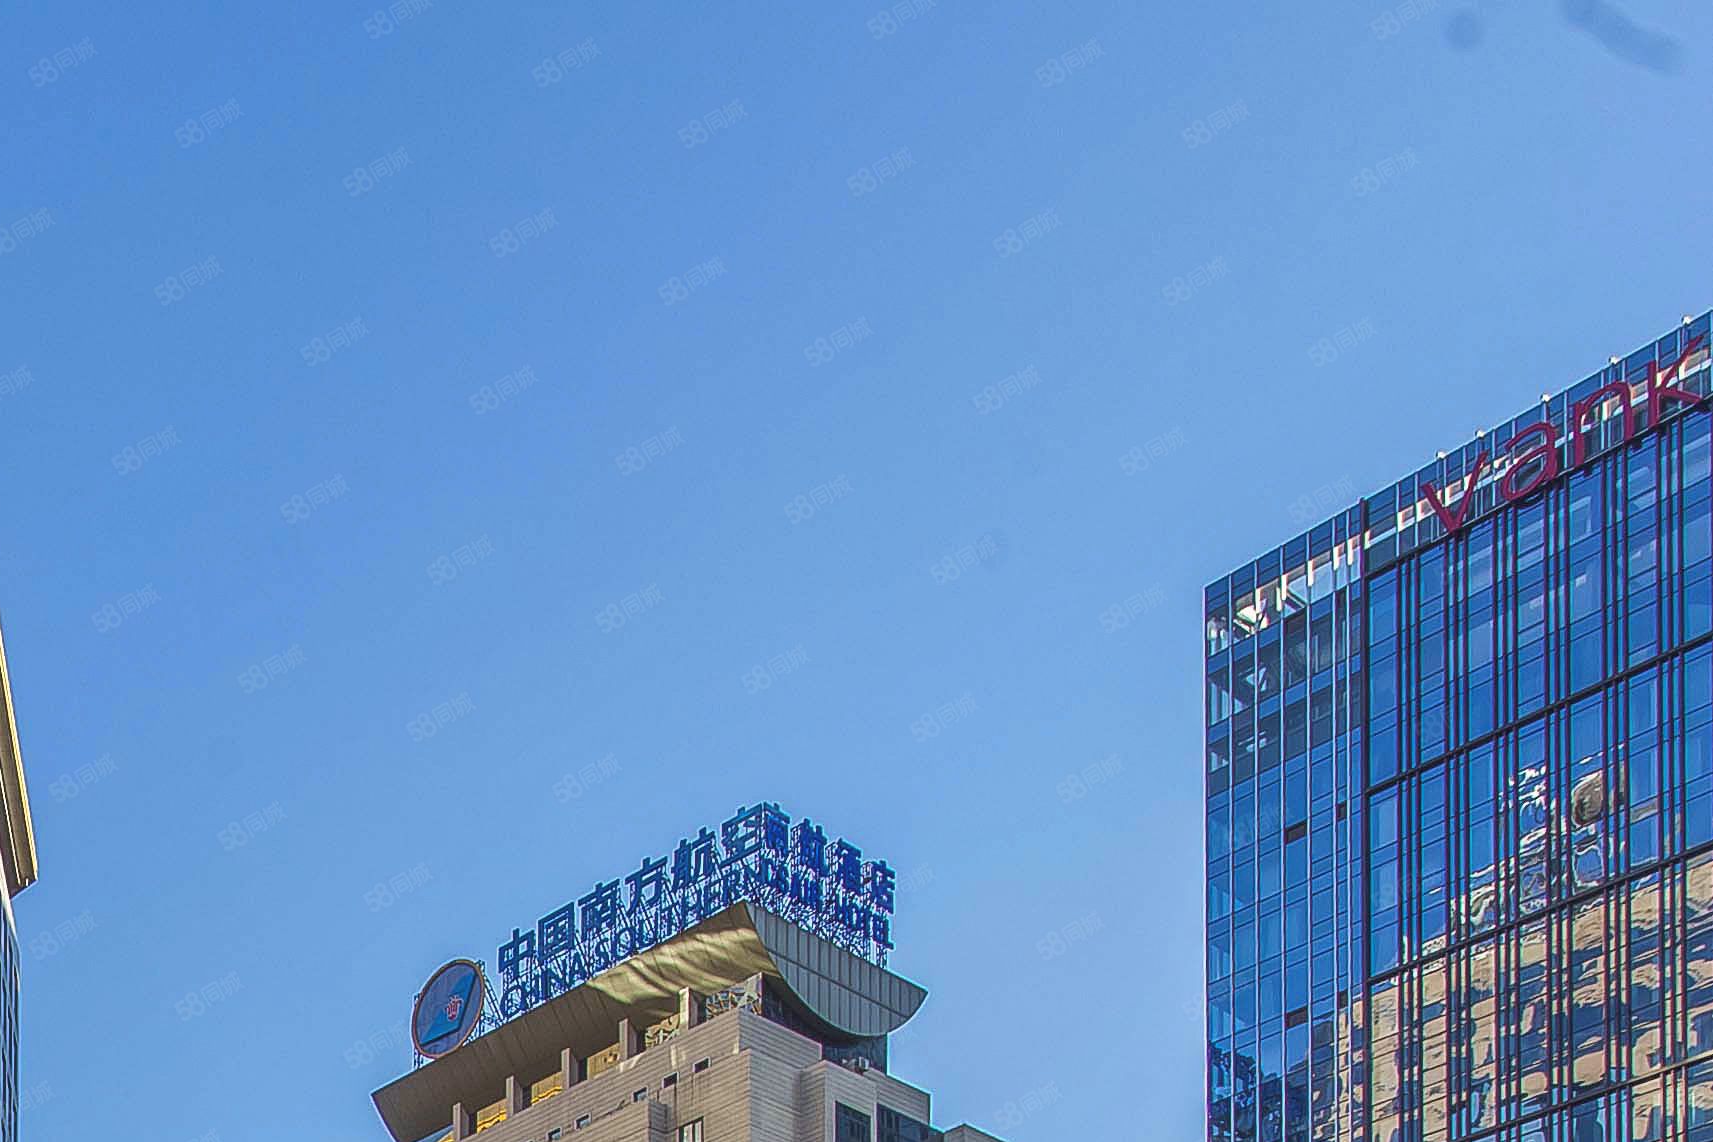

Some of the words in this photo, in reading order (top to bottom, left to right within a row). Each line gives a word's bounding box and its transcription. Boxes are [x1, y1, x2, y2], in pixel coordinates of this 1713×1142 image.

[497, 802, 763, 979] 中国南方航空
